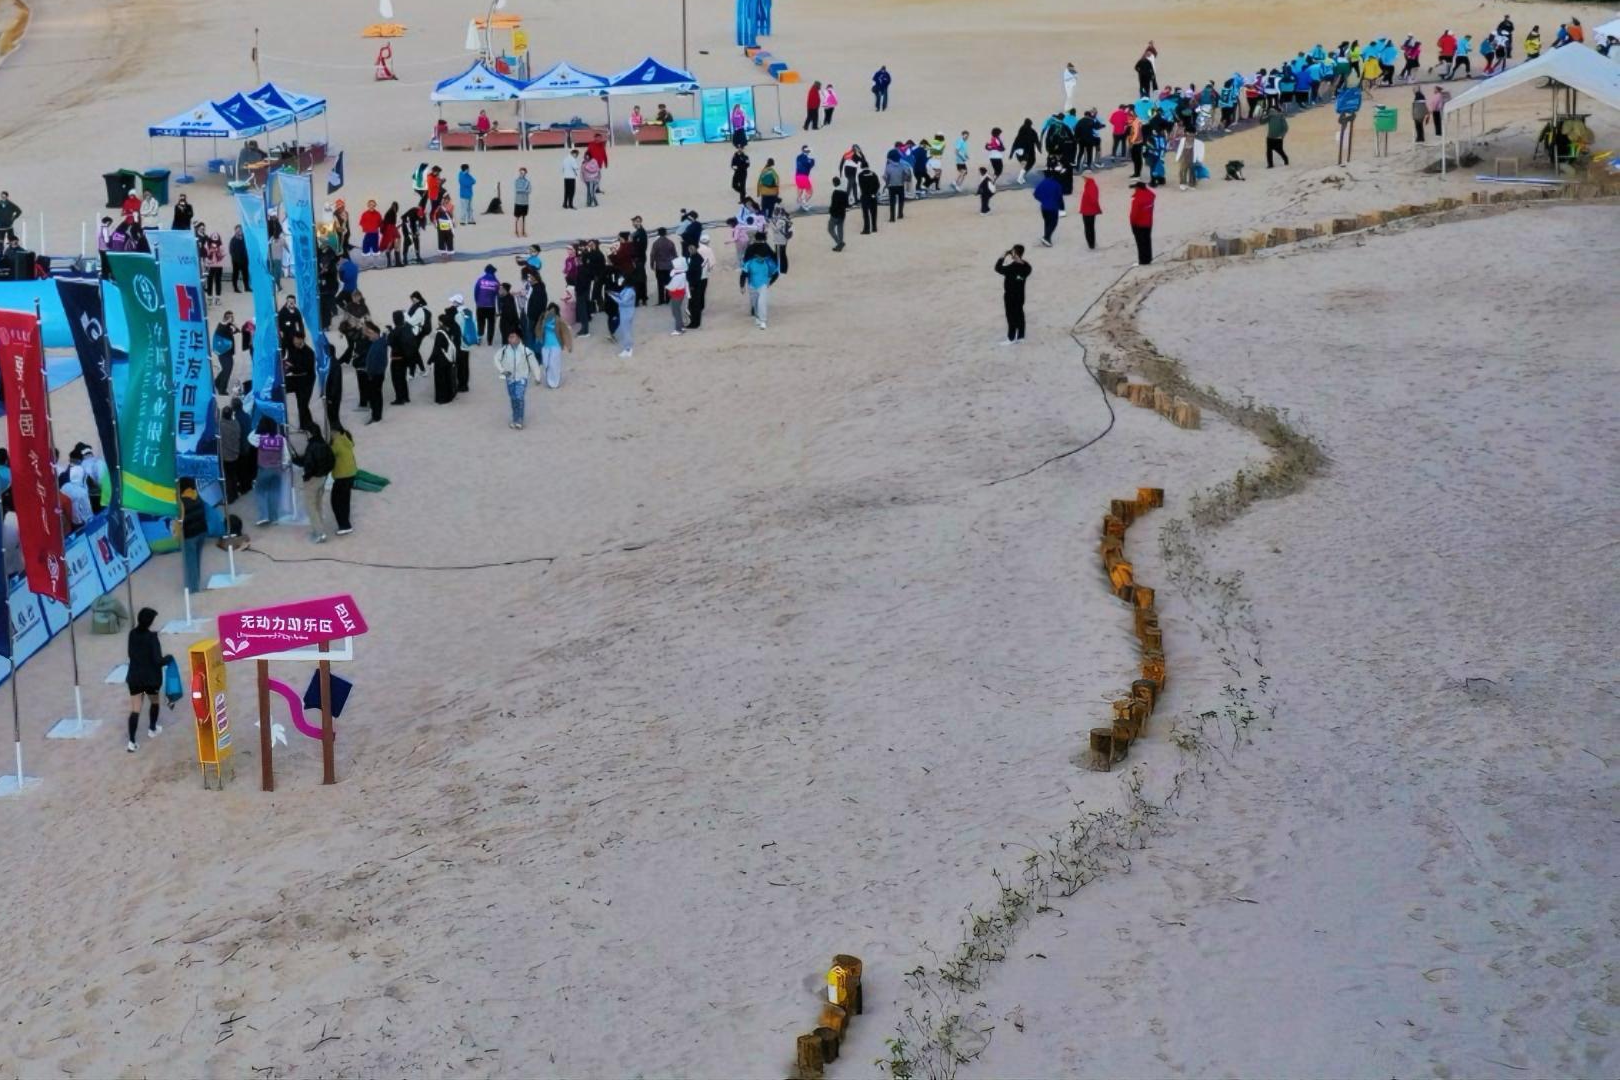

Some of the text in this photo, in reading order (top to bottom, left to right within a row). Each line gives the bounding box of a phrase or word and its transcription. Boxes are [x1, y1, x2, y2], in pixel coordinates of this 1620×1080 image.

[241, 615, 333, 633] 无动力游乐区
